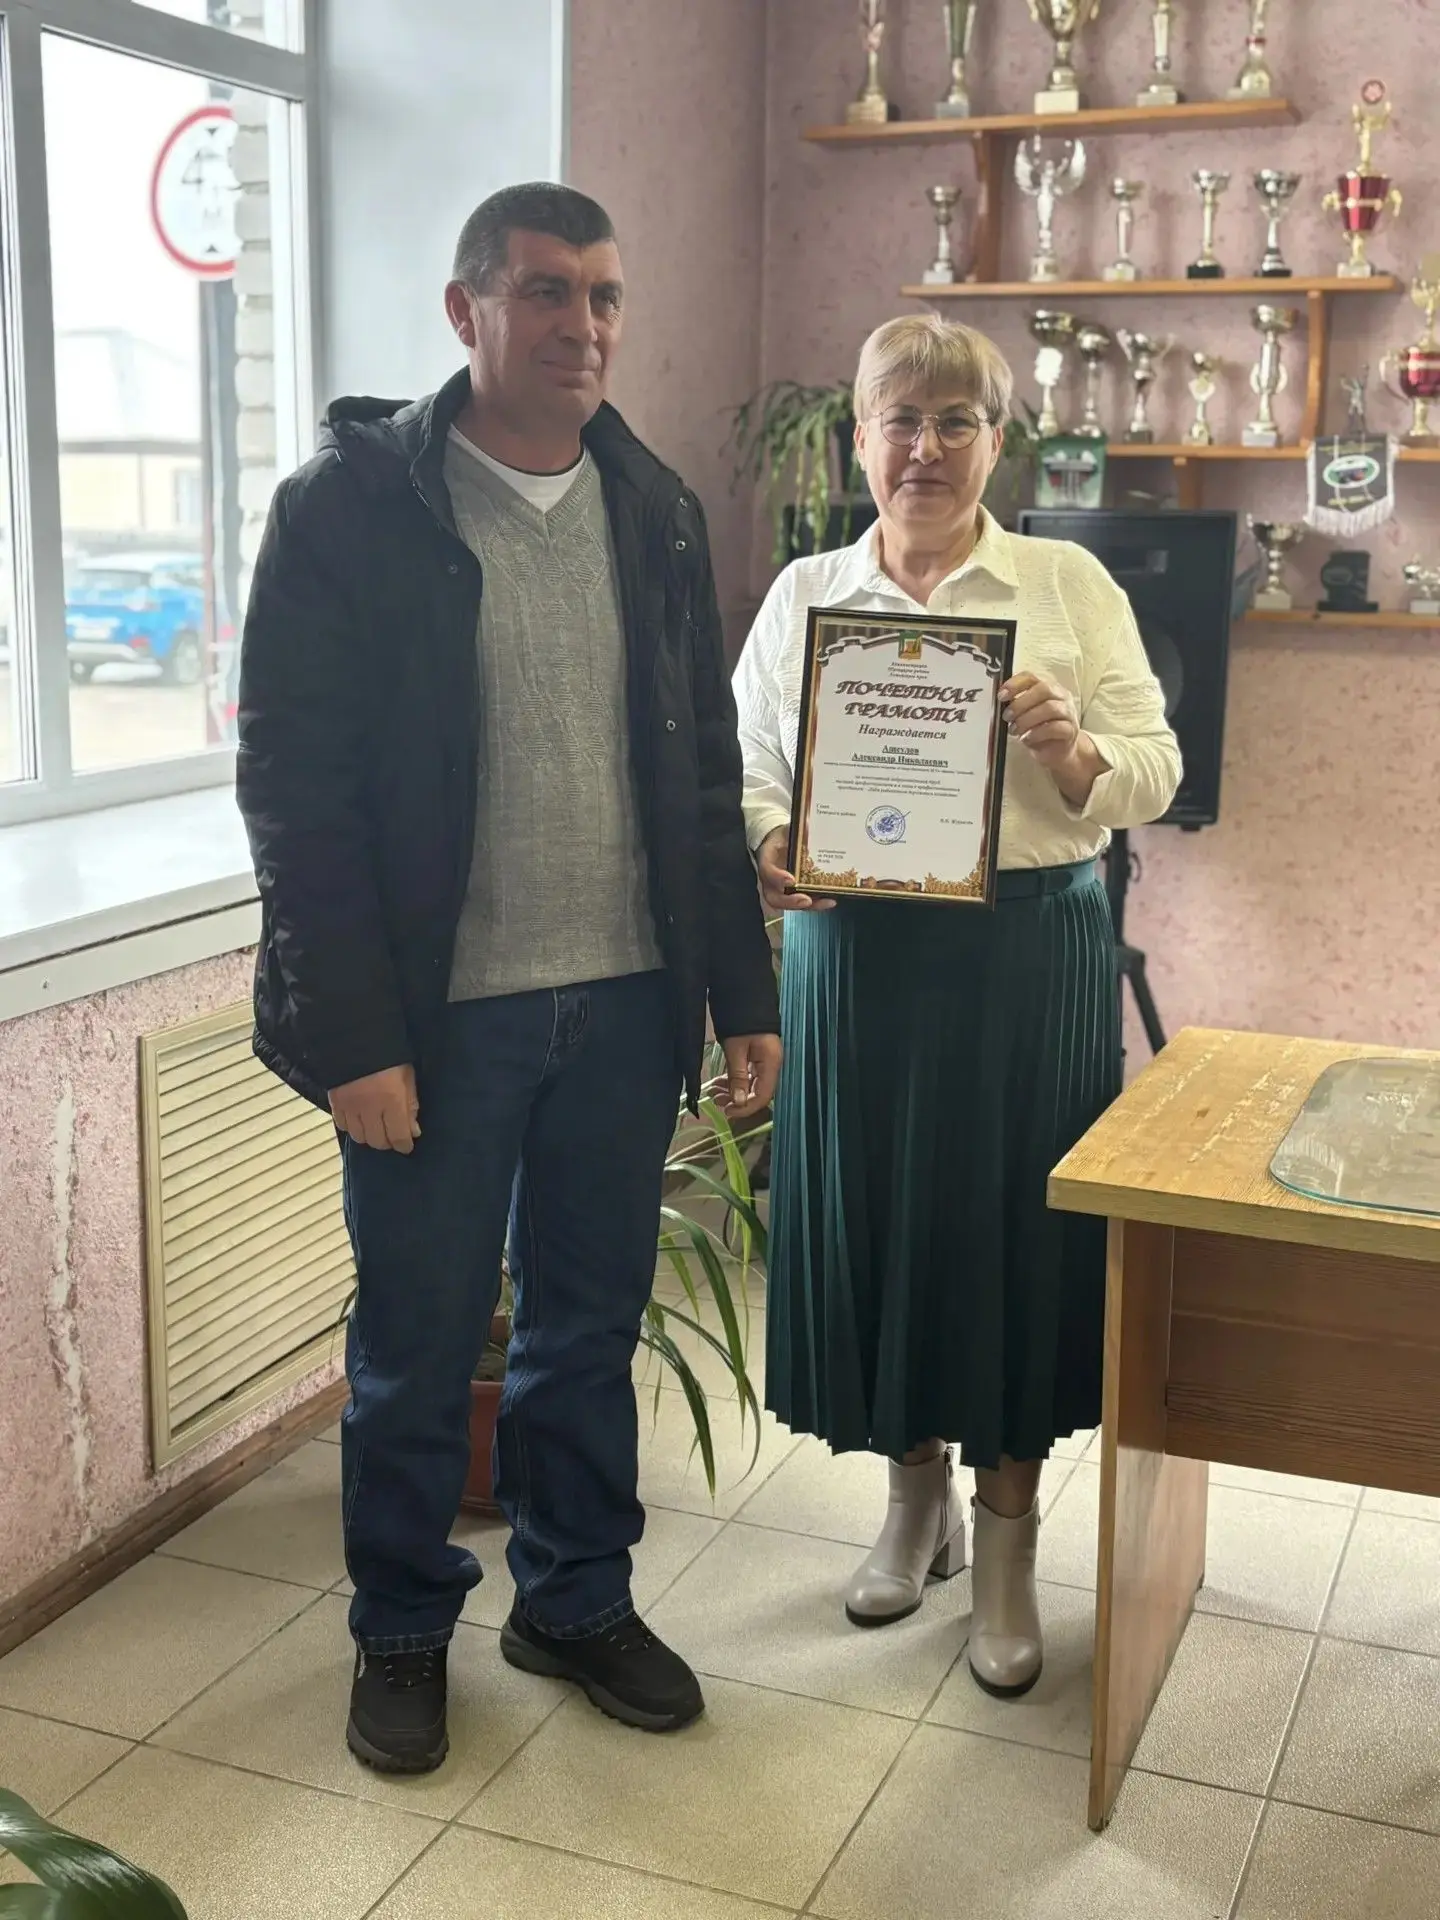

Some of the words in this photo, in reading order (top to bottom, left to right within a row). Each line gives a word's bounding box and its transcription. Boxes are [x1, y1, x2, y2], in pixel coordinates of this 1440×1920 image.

[835, 680, 983, 704] ПОЧЕТНАЯ
[844, 701, 968, 723] ГРАМОТА
[858, 724, 947, 740] Награждается
[851, 752, 896, 764] Александр
[897, 756, 949, 769] Николаевич
